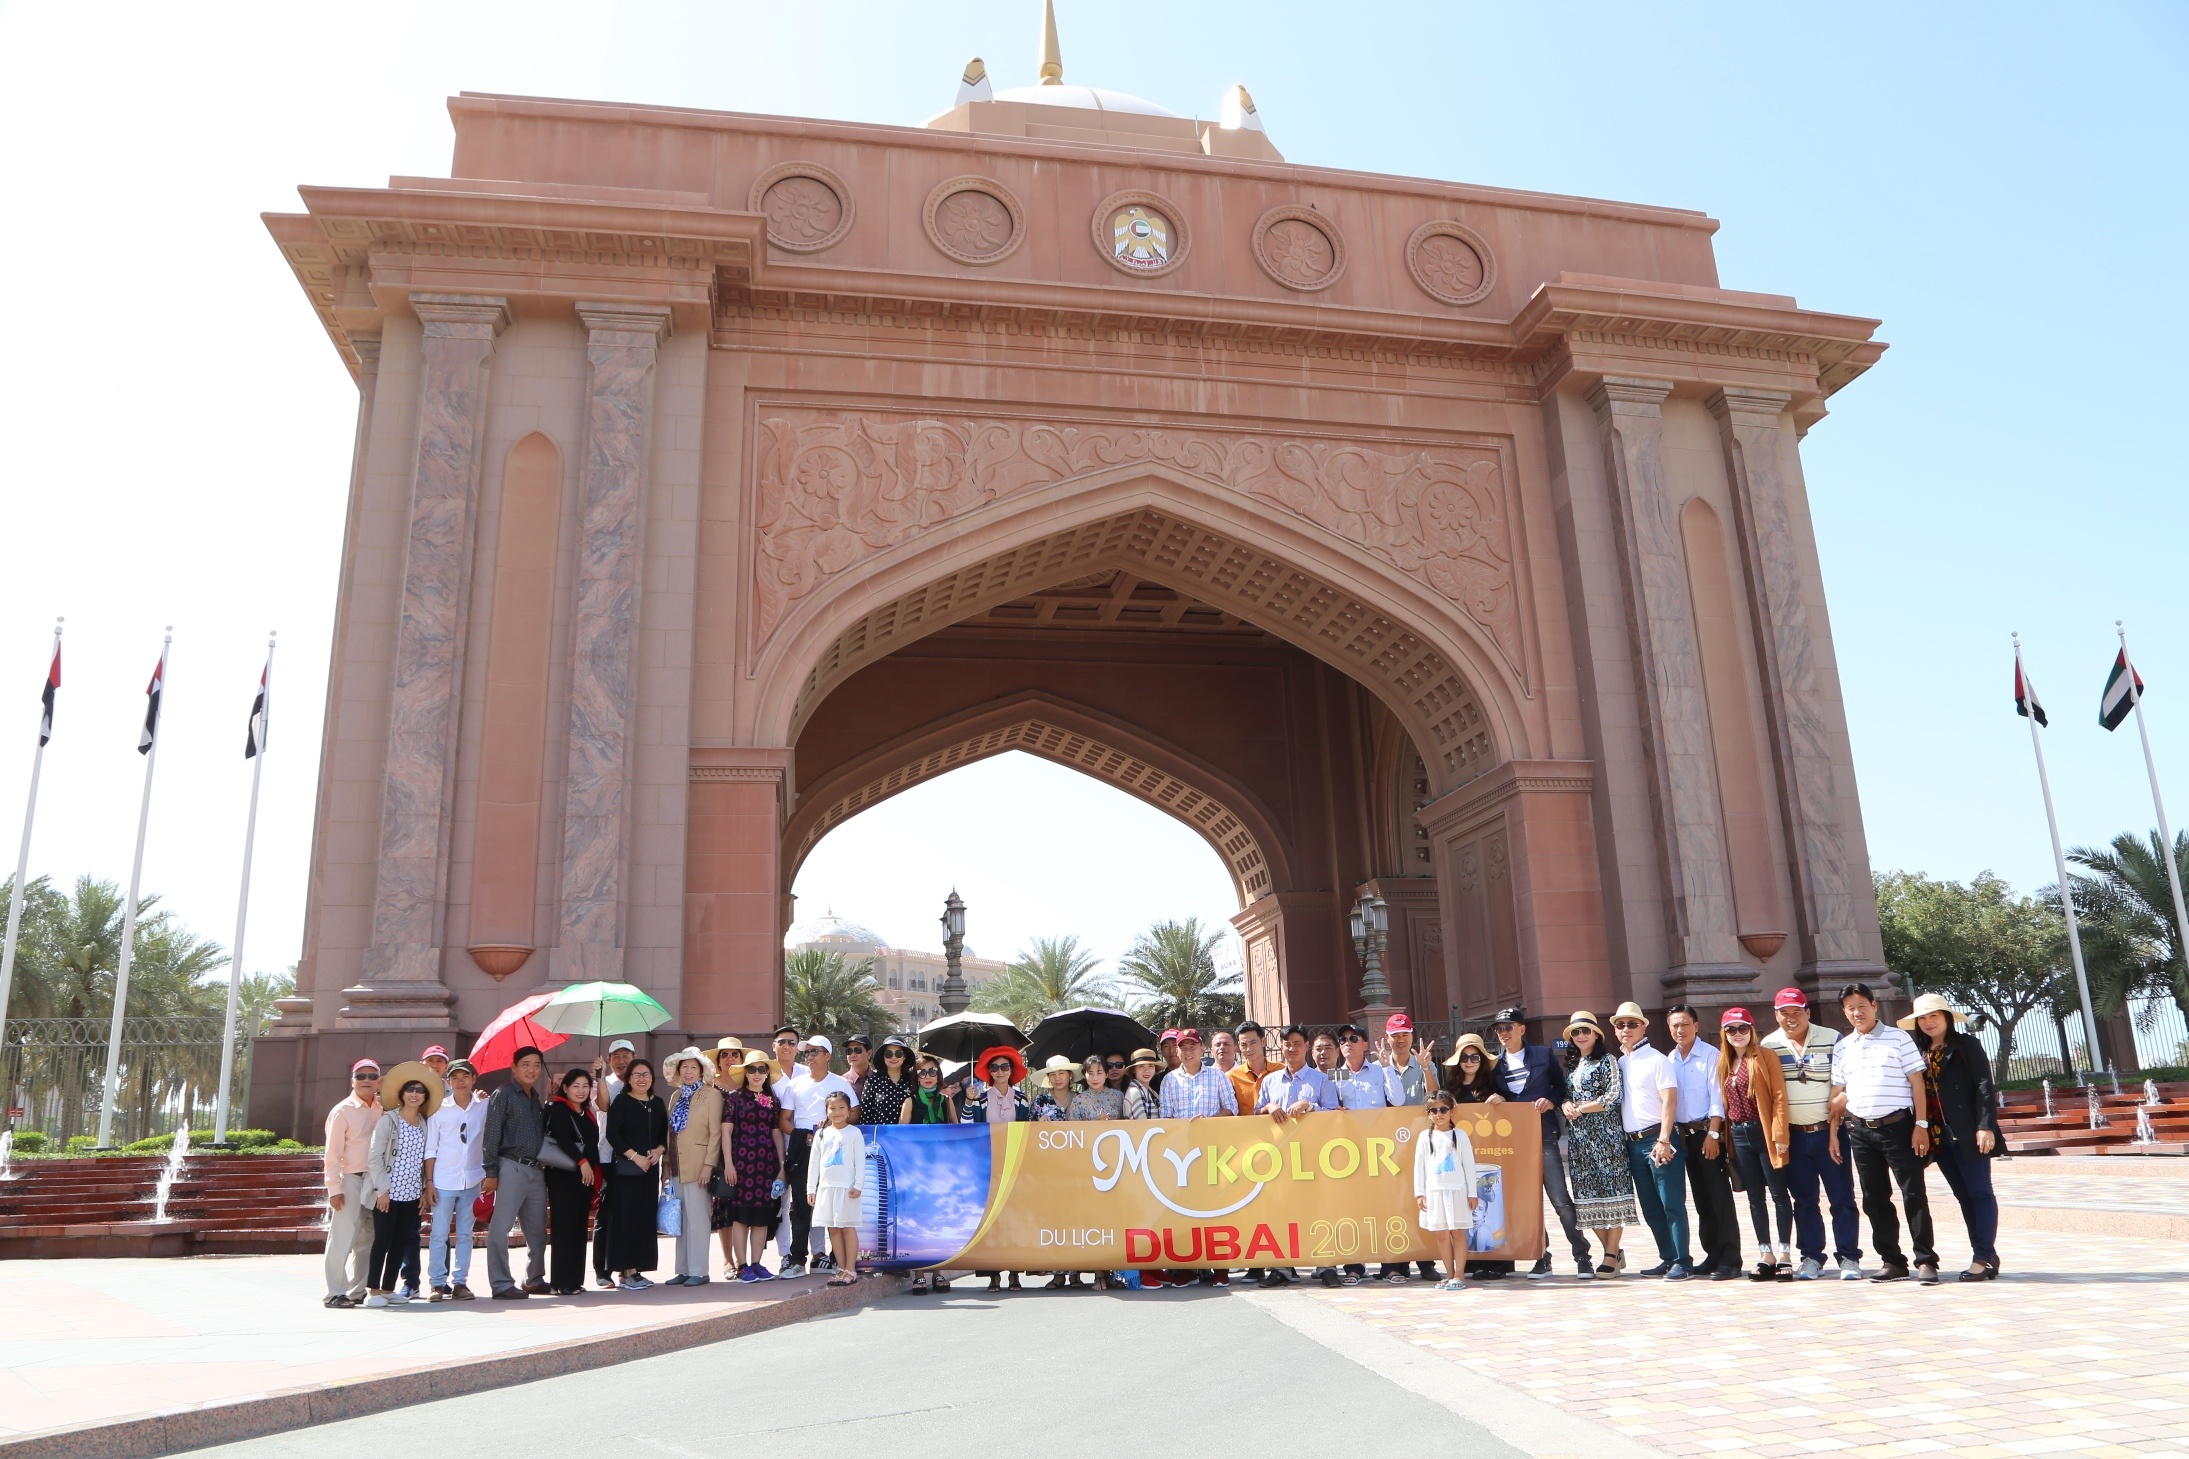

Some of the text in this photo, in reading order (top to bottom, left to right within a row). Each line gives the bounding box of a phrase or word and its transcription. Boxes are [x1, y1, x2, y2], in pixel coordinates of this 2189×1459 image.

[1039, 1130, 1084, 1149] SƠN
[1474, 1147, 1514, 1157] ranges
[1476, 1175, 1500, 1186] OLOR
[1040, 1216, 1410, 1263] DU LỊCH DUBAI 2018
